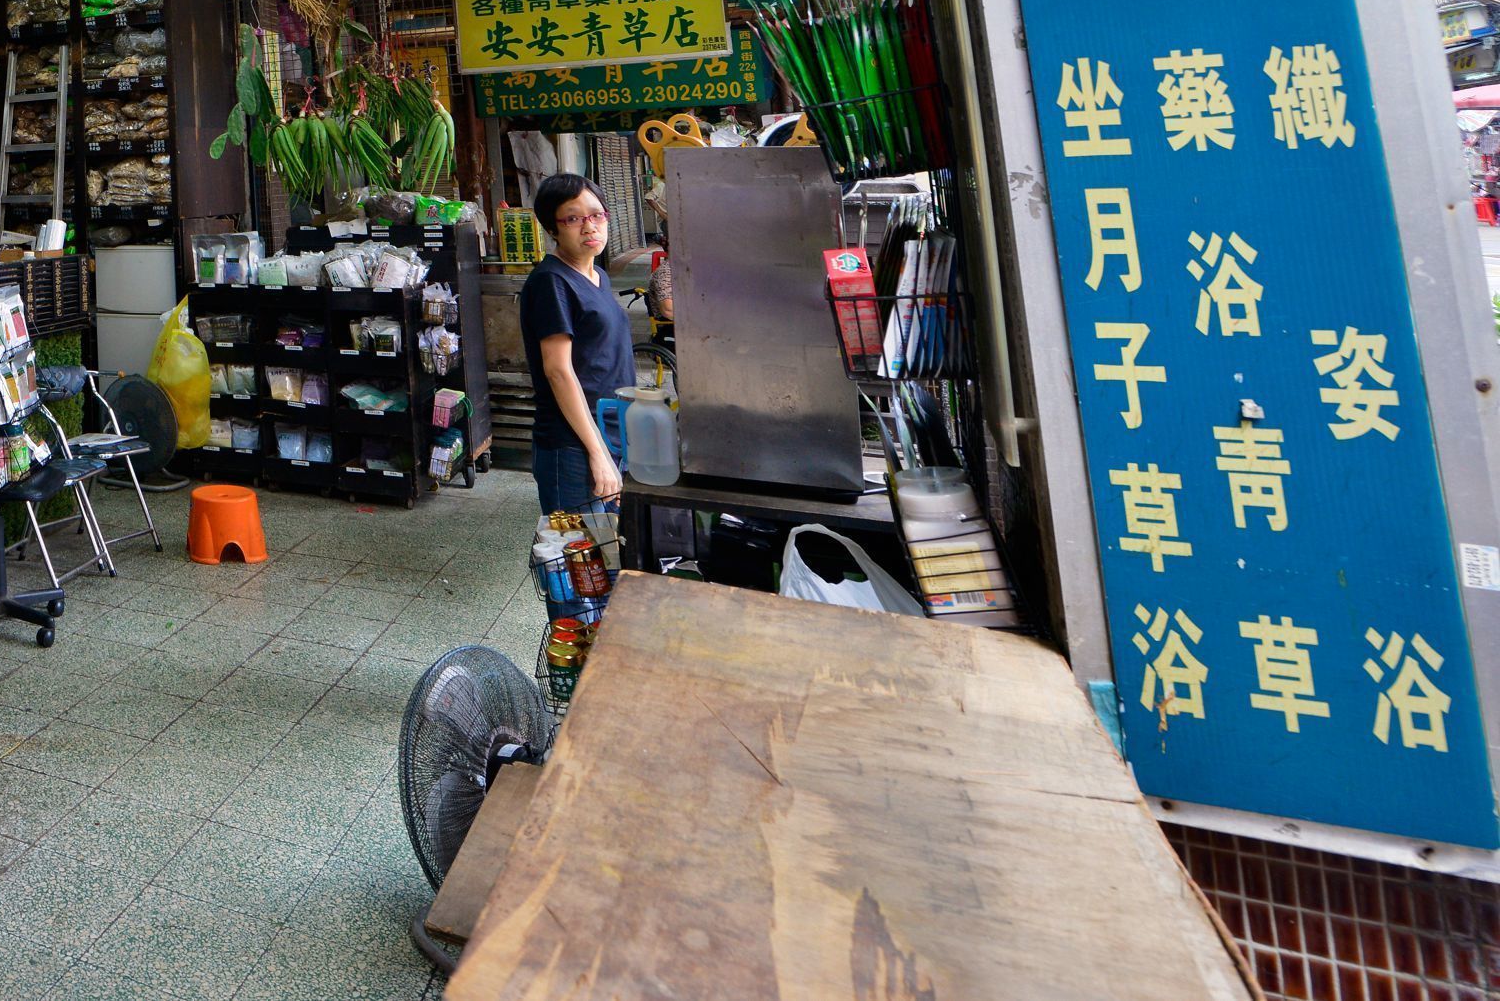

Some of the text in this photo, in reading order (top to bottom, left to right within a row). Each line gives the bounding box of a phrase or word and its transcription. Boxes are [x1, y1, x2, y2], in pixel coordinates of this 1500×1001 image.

[481, 5, 700, 61] 安安青草店
[1056, 57, 1209, 720] 坐月子草浴
